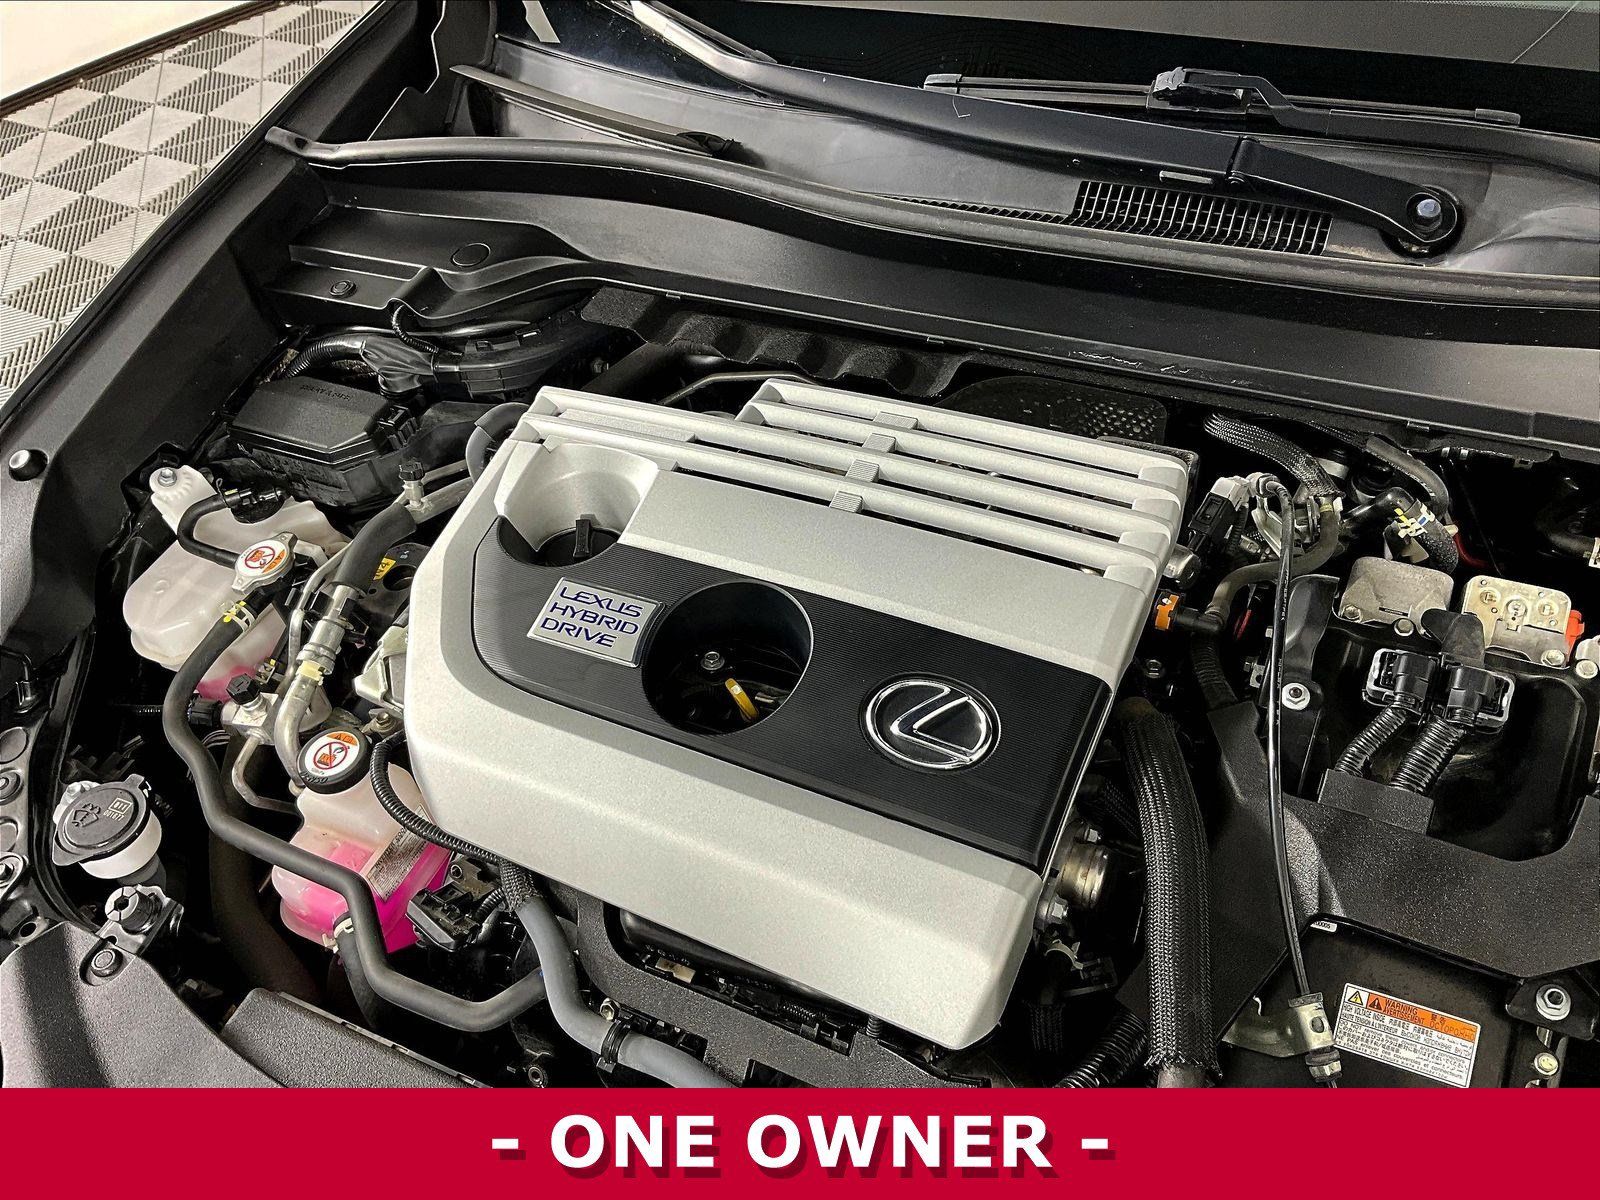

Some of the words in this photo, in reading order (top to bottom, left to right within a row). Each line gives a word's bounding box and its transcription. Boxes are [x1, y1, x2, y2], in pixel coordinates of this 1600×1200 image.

[560, 586, 643, 618] LEXUS
[540, 617, 618, 648] DRIVE
[549, 601, 639, 635] HYBRID
[1382, 1005, 1424, 1025] AVERTISSEMENT
[1384, 998, 1418, 1015] WARNING
